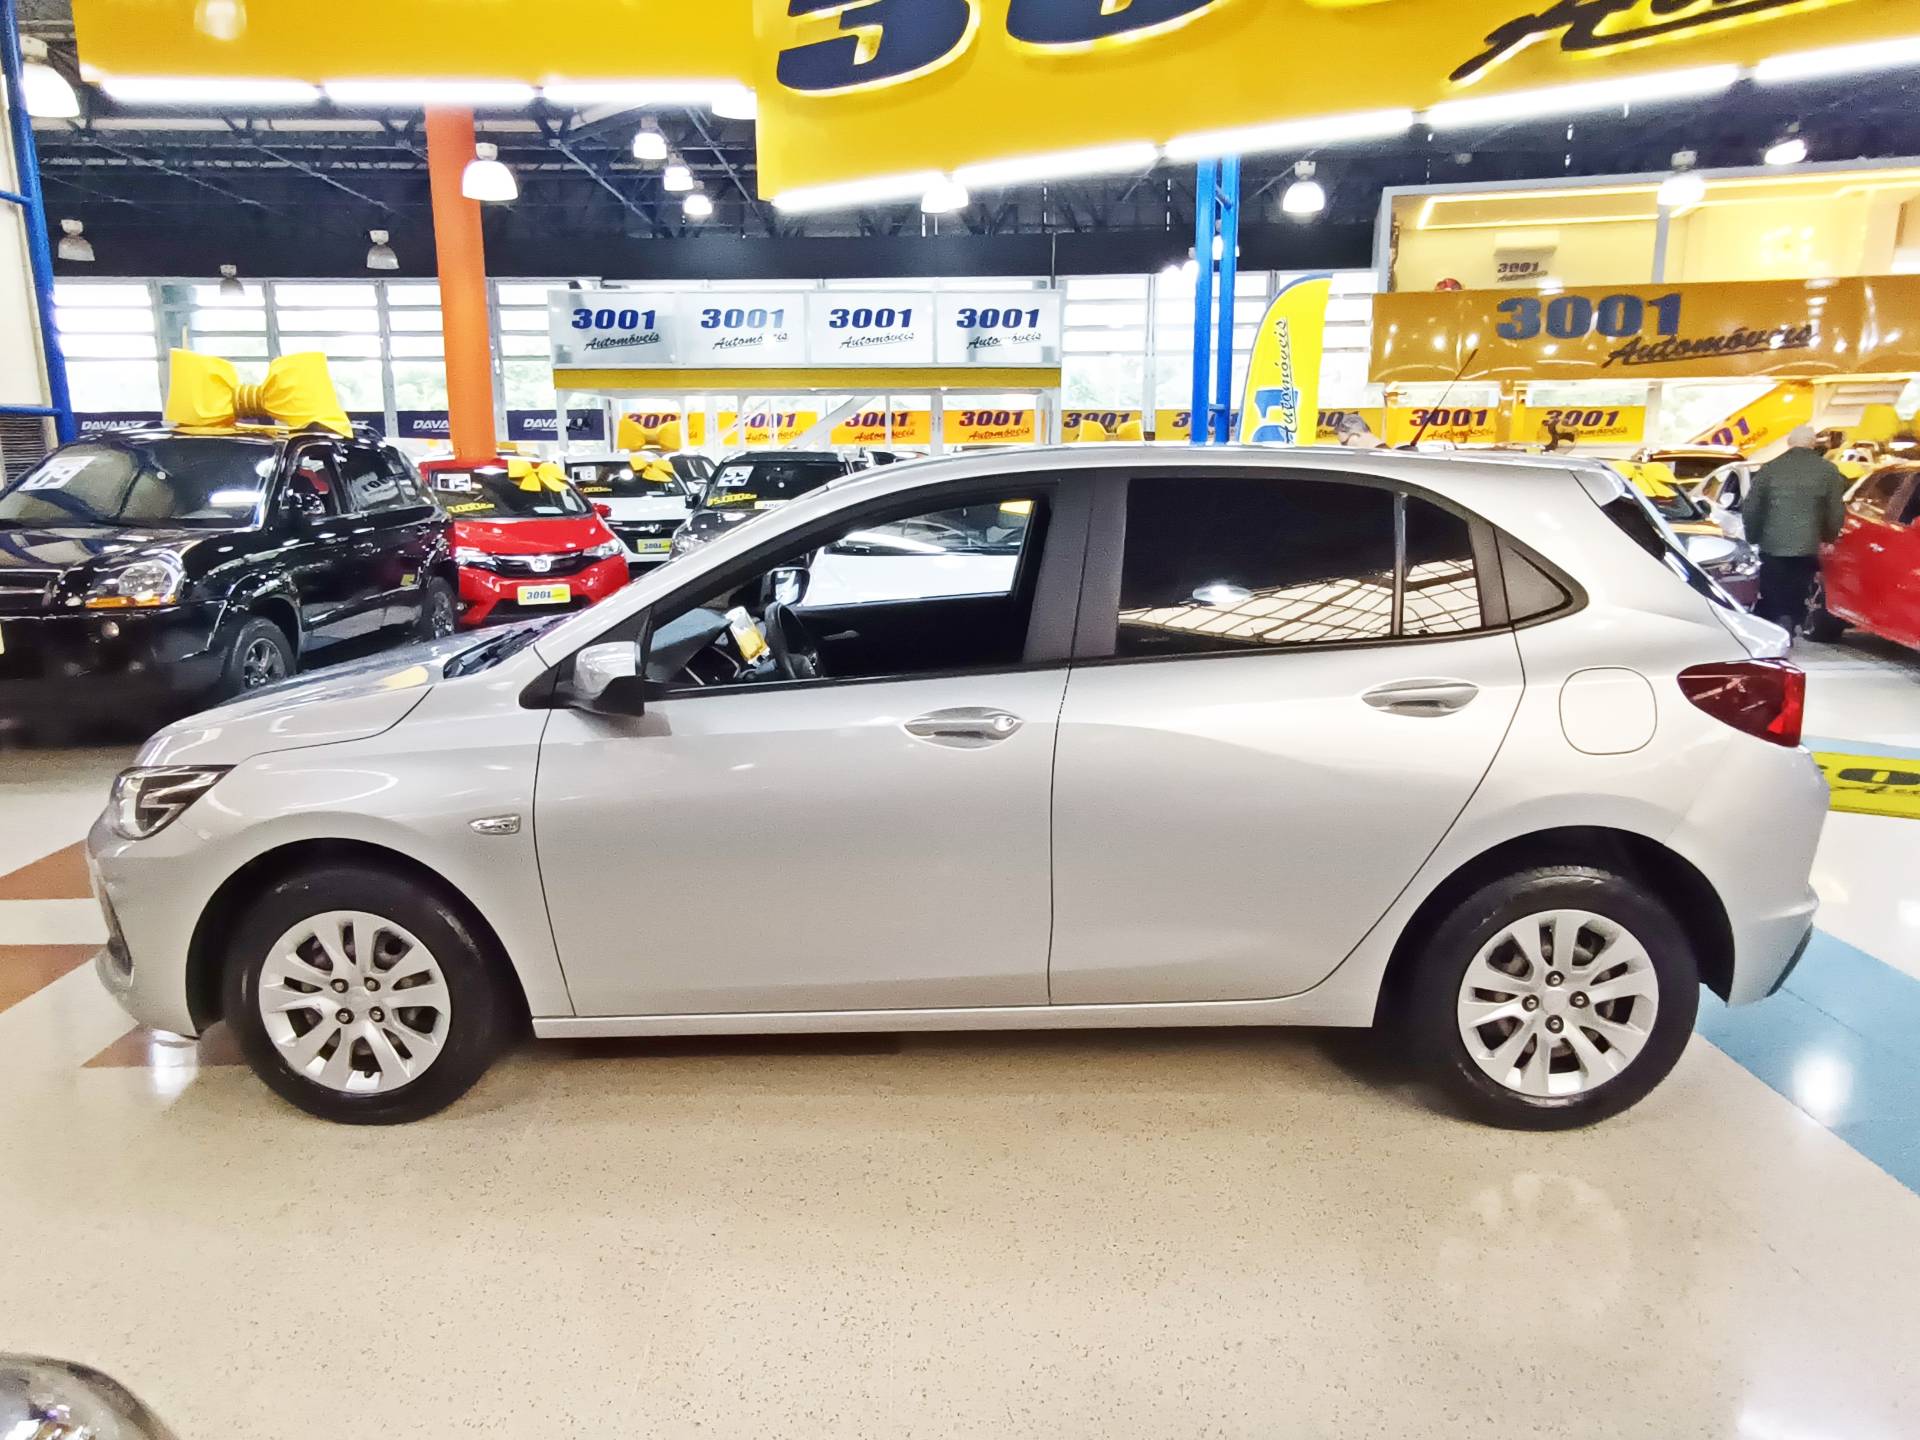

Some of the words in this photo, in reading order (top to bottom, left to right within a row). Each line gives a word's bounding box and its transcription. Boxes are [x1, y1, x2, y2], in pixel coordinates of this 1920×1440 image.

[571, 308, 656, 330] 3001
[701, 308, 785, 329] 3001
[829, 308, 912, 329] 3001
[956, 308, 1040, 329] 3001
[1495, 292, 1683, 341] 3001
[584, 332, 661, 351] Automóveis
[712, 332, 789, 350] Automóis
[839, 332, 915, 349] Automóveis
[966, 332, 1042, 349] Autoóveis
[1601, 323, 1818, 369] Automóveis
[413, 420, 449, 429] DAVA
[959, 411, 1024, 427] 3001
[1409, 408, 1488, 426] 3001
[1542, 410, 1620, 427] 3001
[526, 590, 552, 600] 3001
